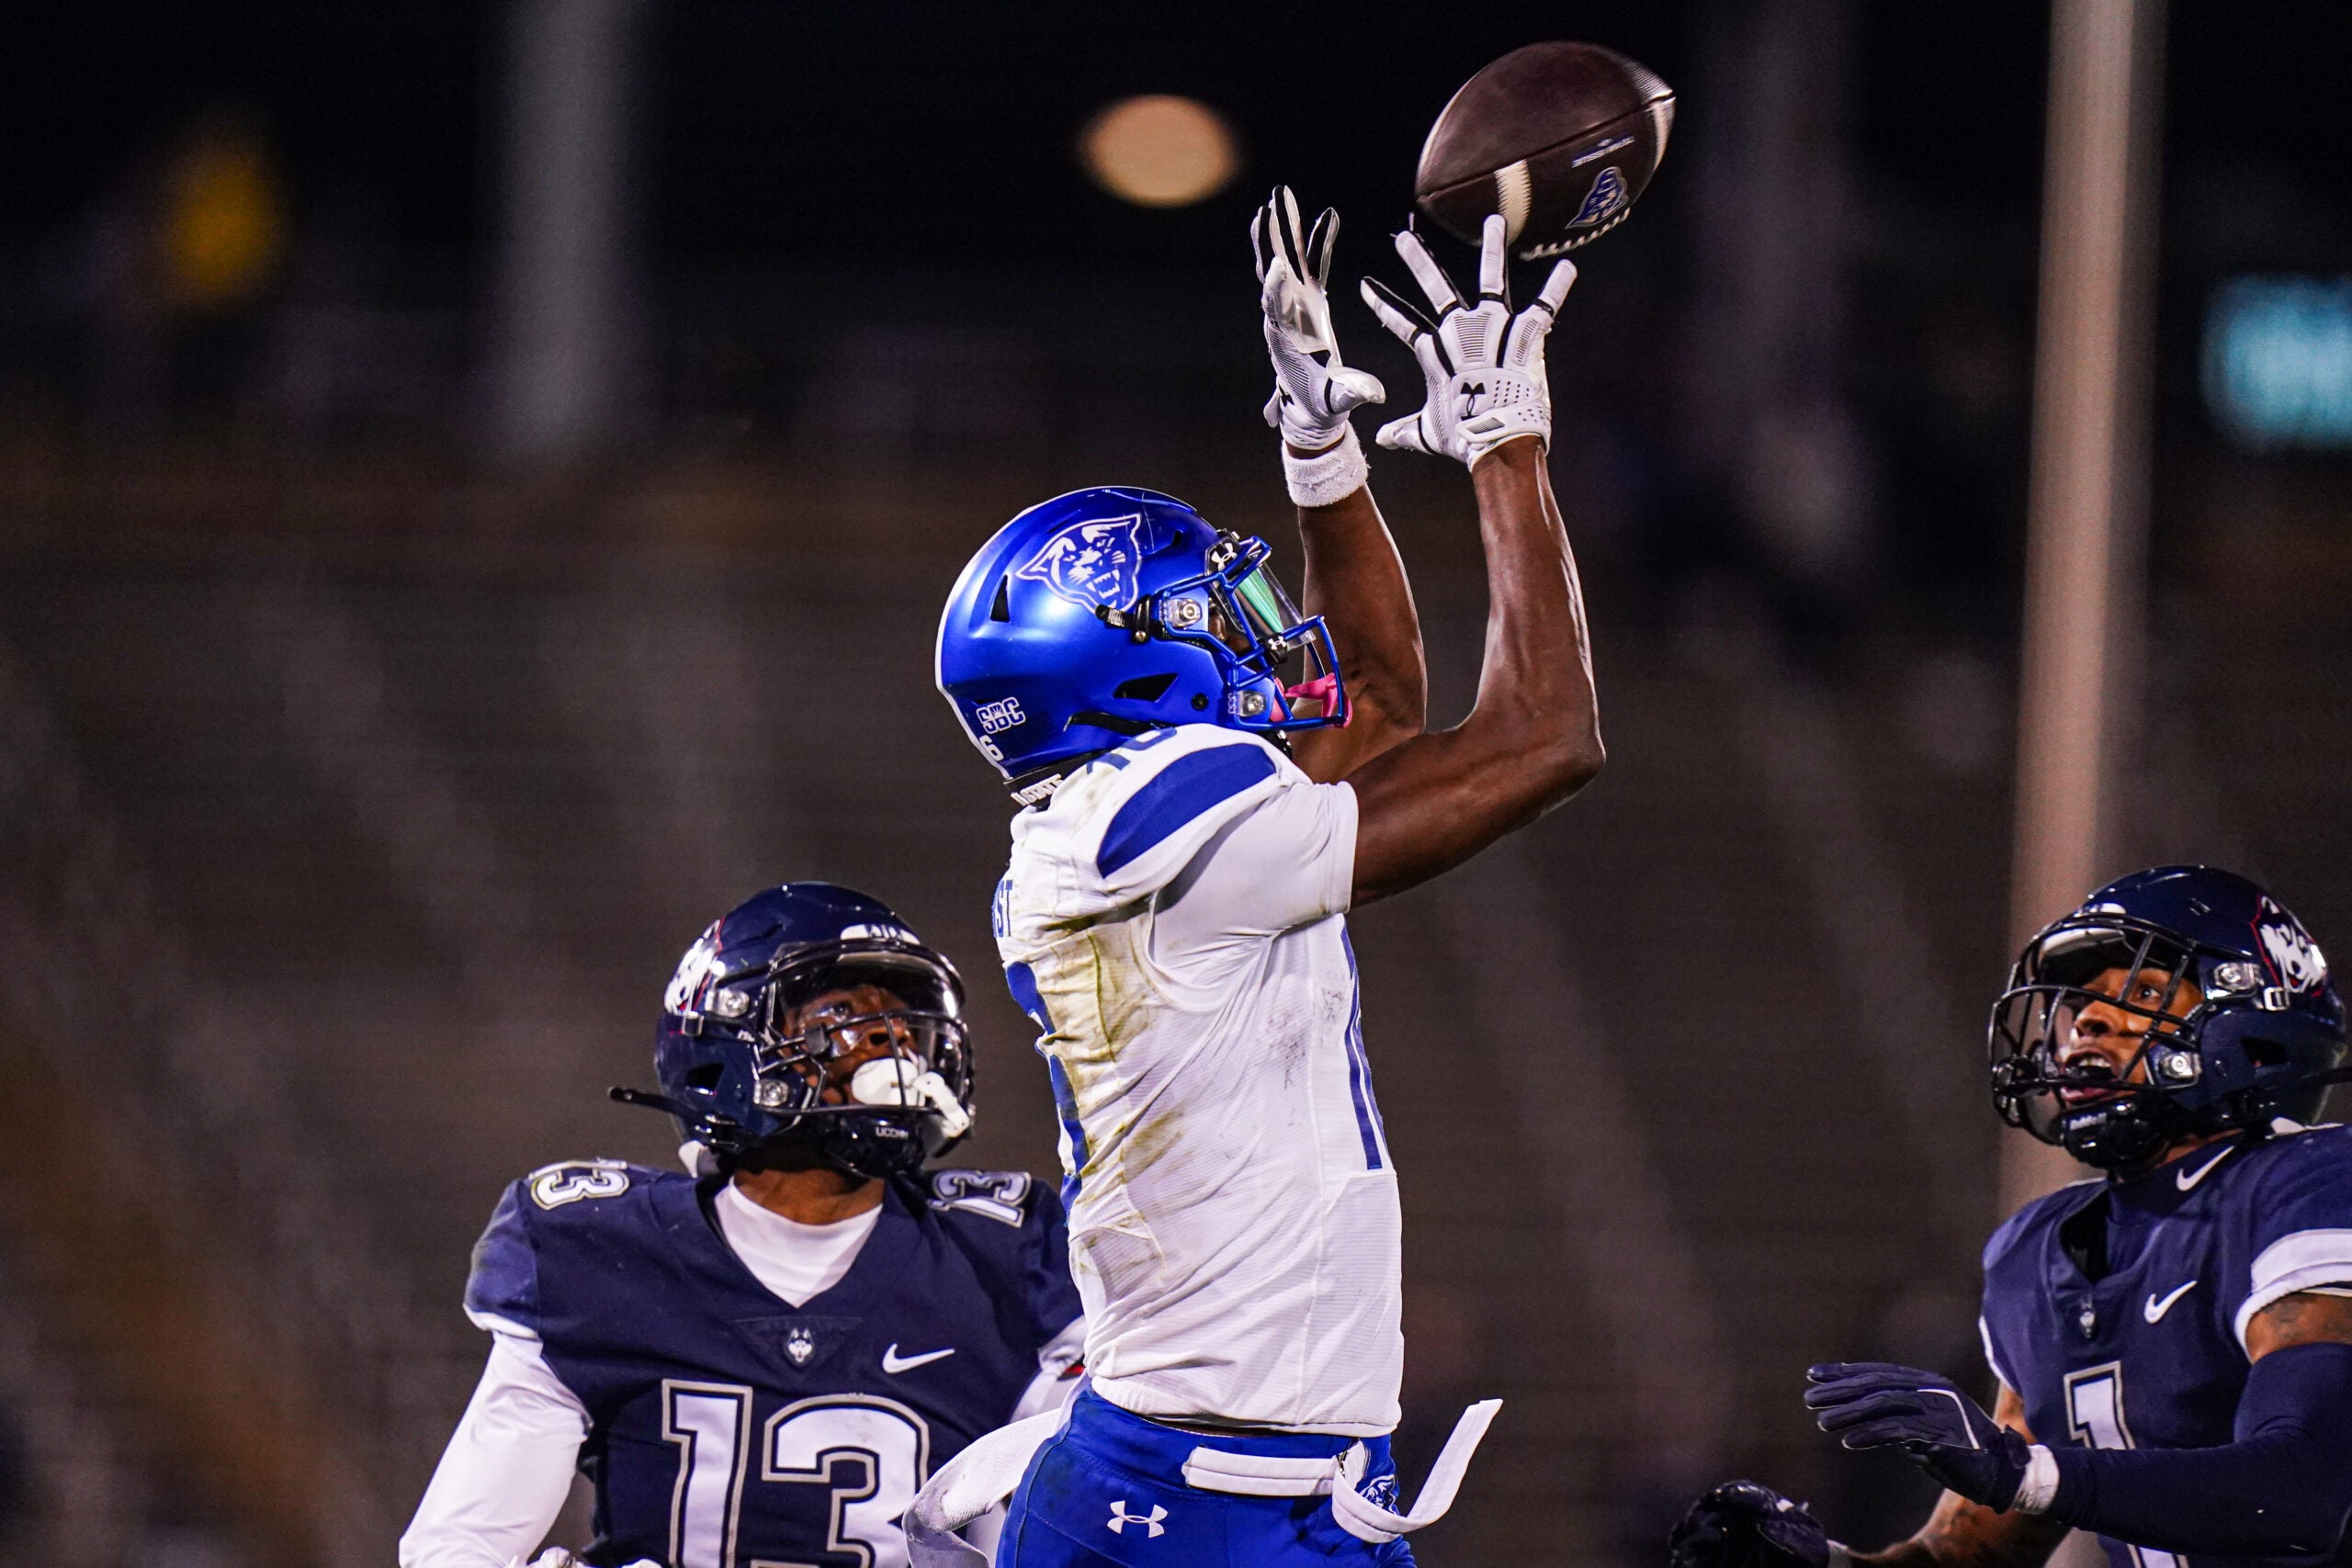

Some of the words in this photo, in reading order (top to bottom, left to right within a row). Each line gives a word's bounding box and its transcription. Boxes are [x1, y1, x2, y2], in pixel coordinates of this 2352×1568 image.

[976, 696, 1026, 734] SBC
[979, 735, 1004, 761] 6
[662, 1378, 930, 1568] 13
